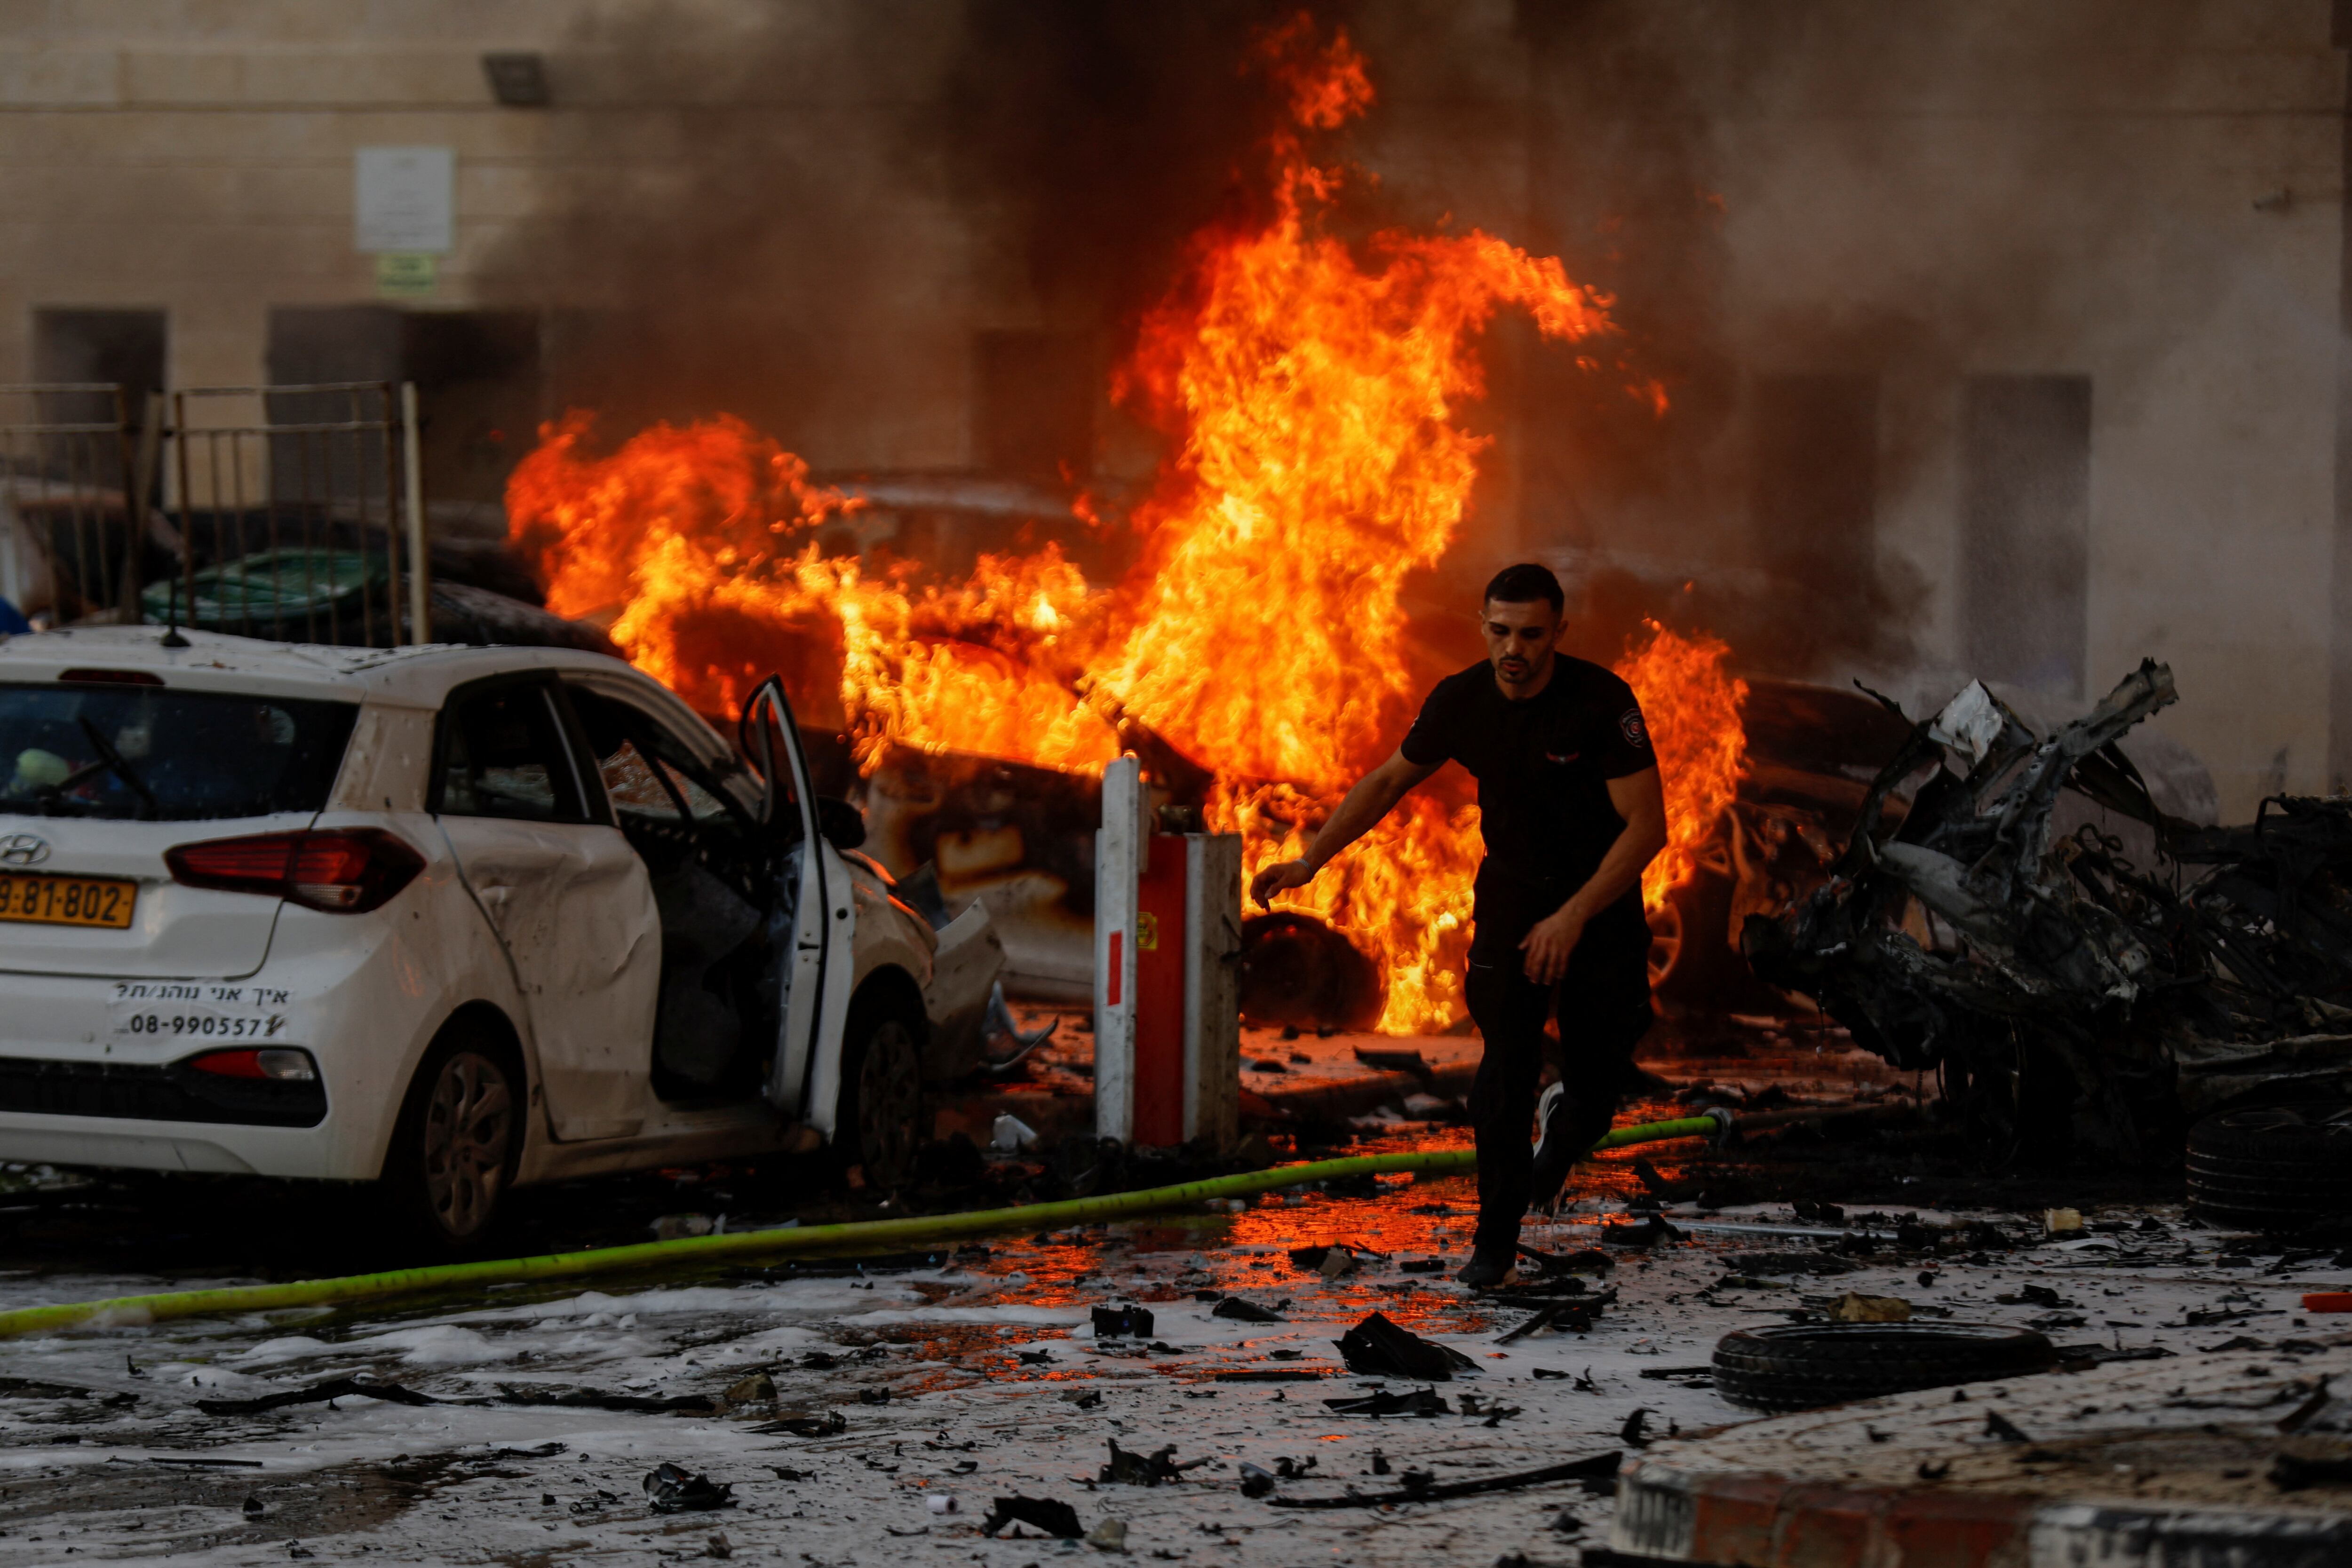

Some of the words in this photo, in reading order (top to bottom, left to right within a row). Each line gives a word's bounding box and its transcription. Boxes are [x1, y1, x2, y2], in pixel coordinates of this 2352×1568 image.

[117, 984, 199, 999] נוהג/ת?
[210, 987, 241, 1001] אני
[252, 988, 289, 1006] איך
